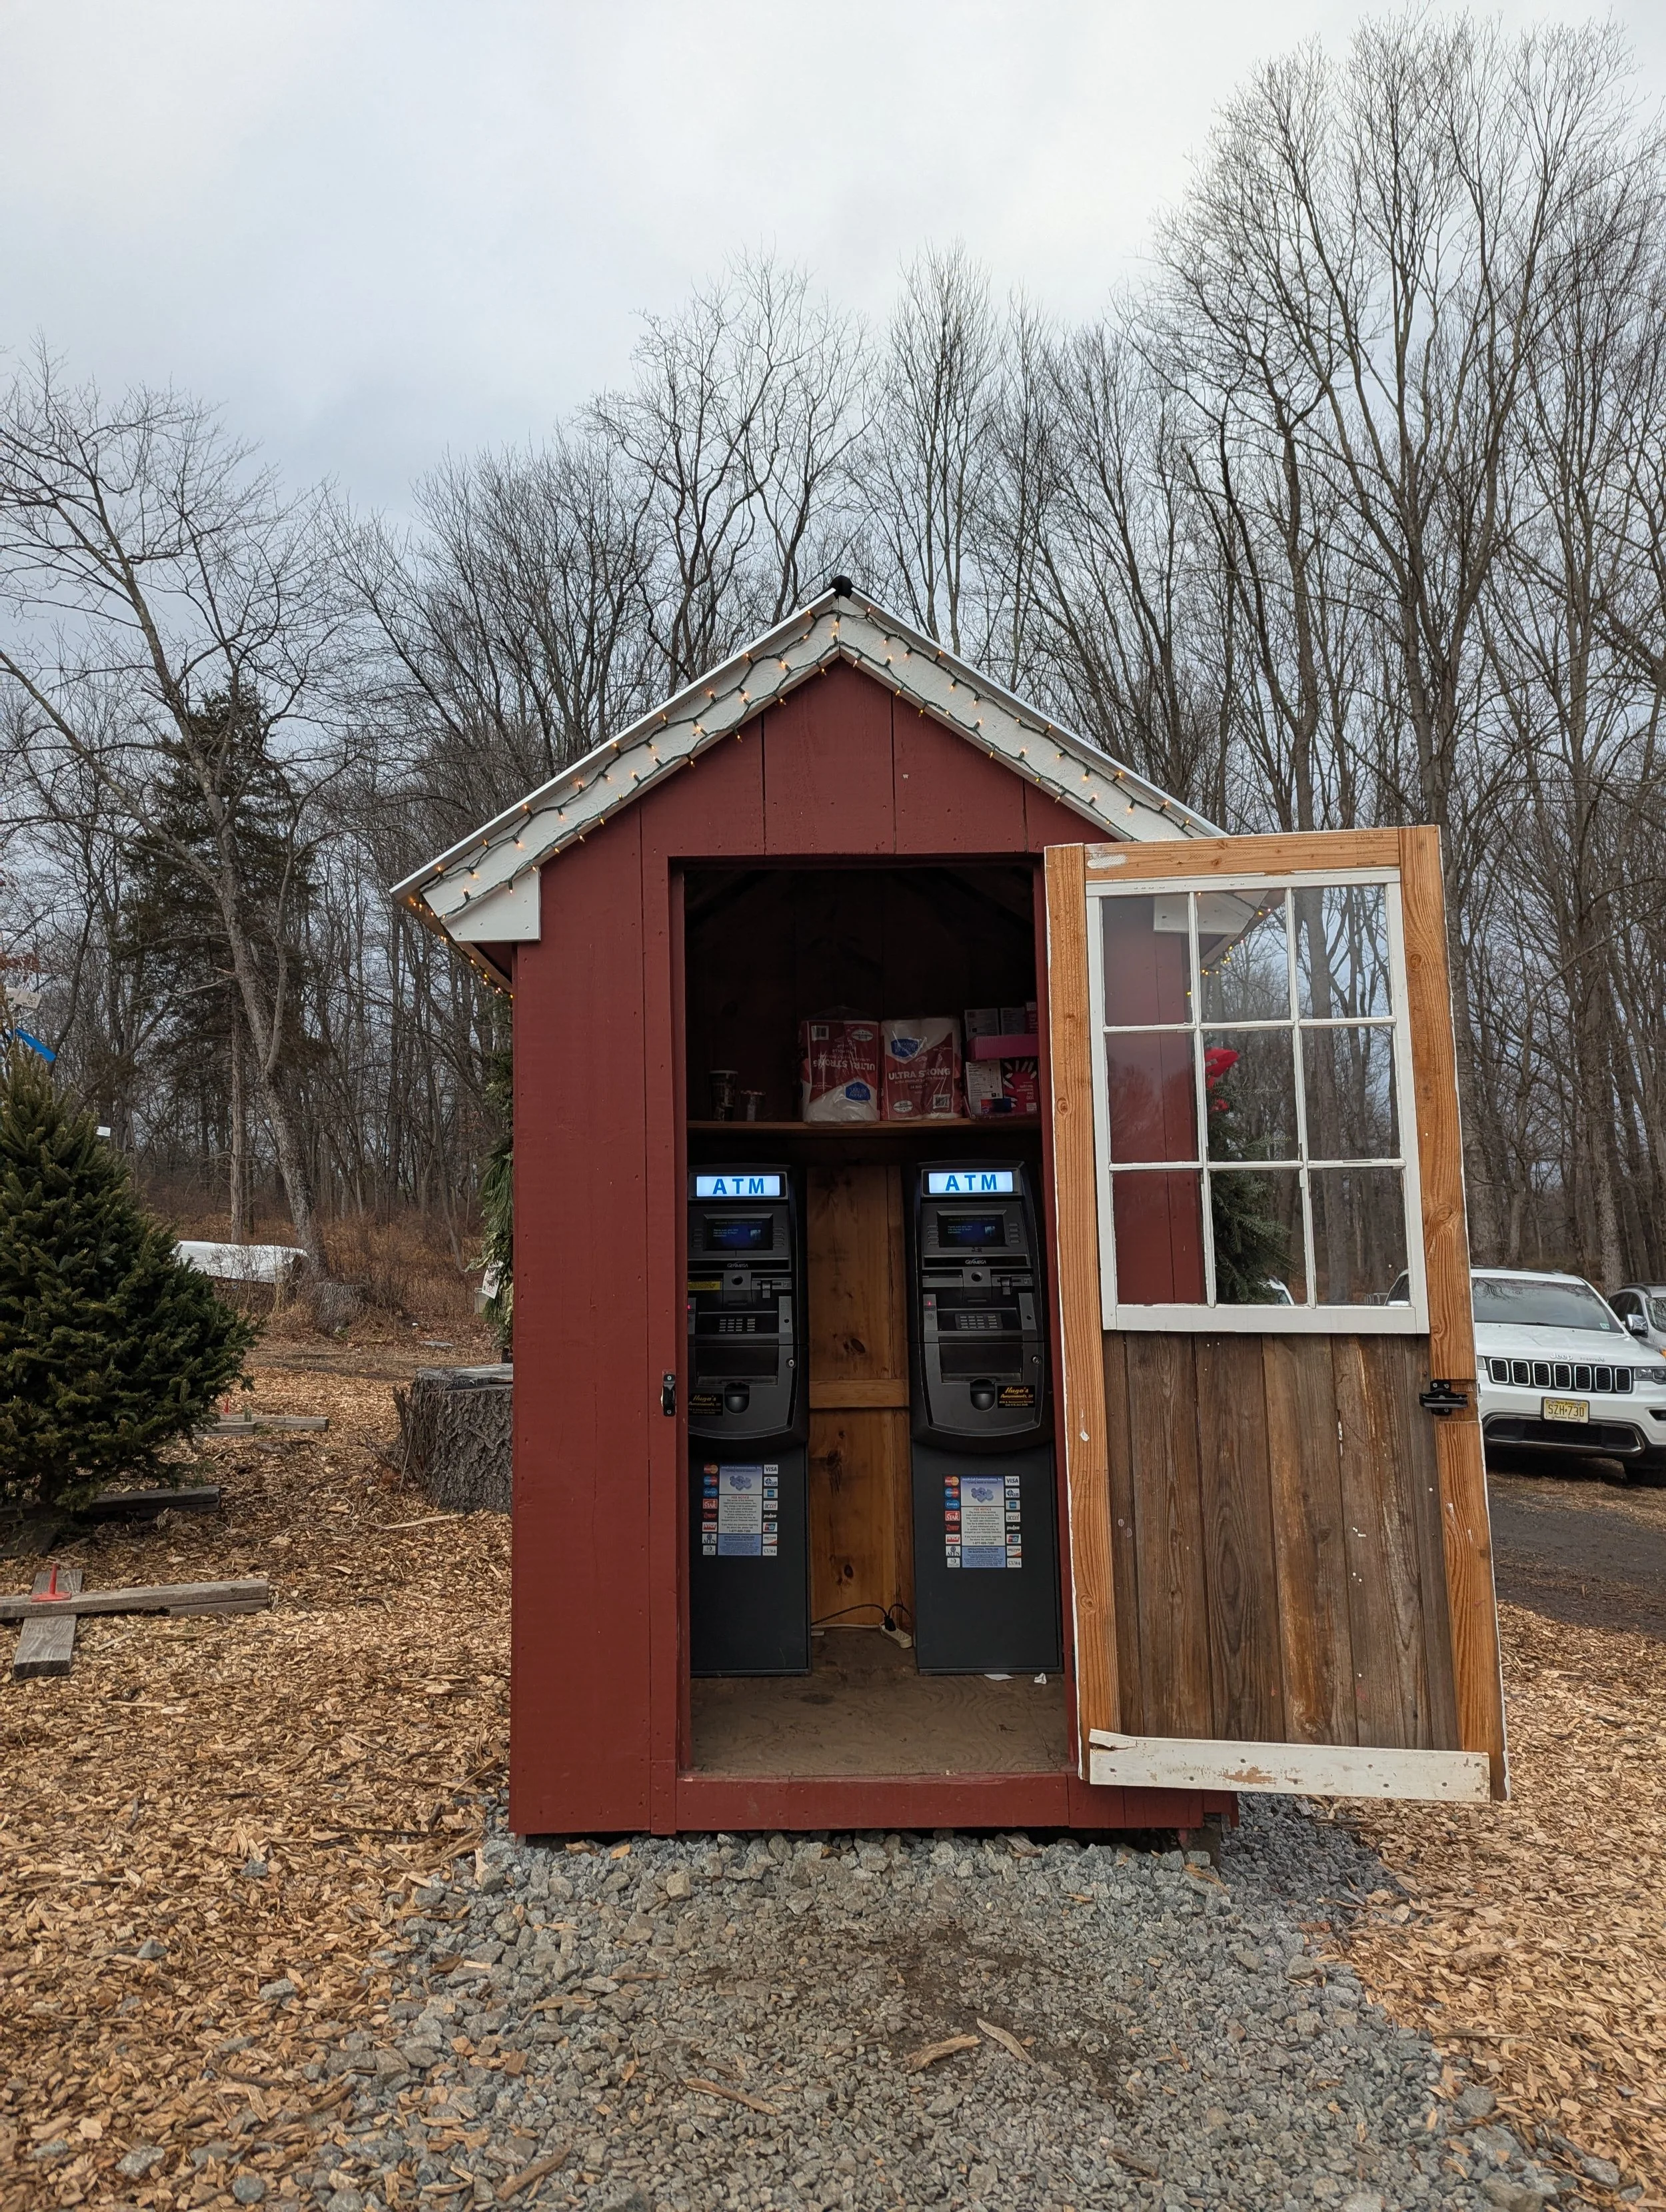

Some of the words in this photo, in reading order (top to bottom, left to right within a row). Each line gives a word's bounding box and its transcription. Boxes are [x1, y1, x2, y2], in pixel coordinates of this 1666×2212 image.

[888, 1071, 916, 1081] ULTRA
[918, 1067, 951, 1079] STRONG
[712, 1178, 764, 1195] ATM
[945, 1175, 997, 1191] ATM
[1550, 1353, 1573, 1361] Jeep
